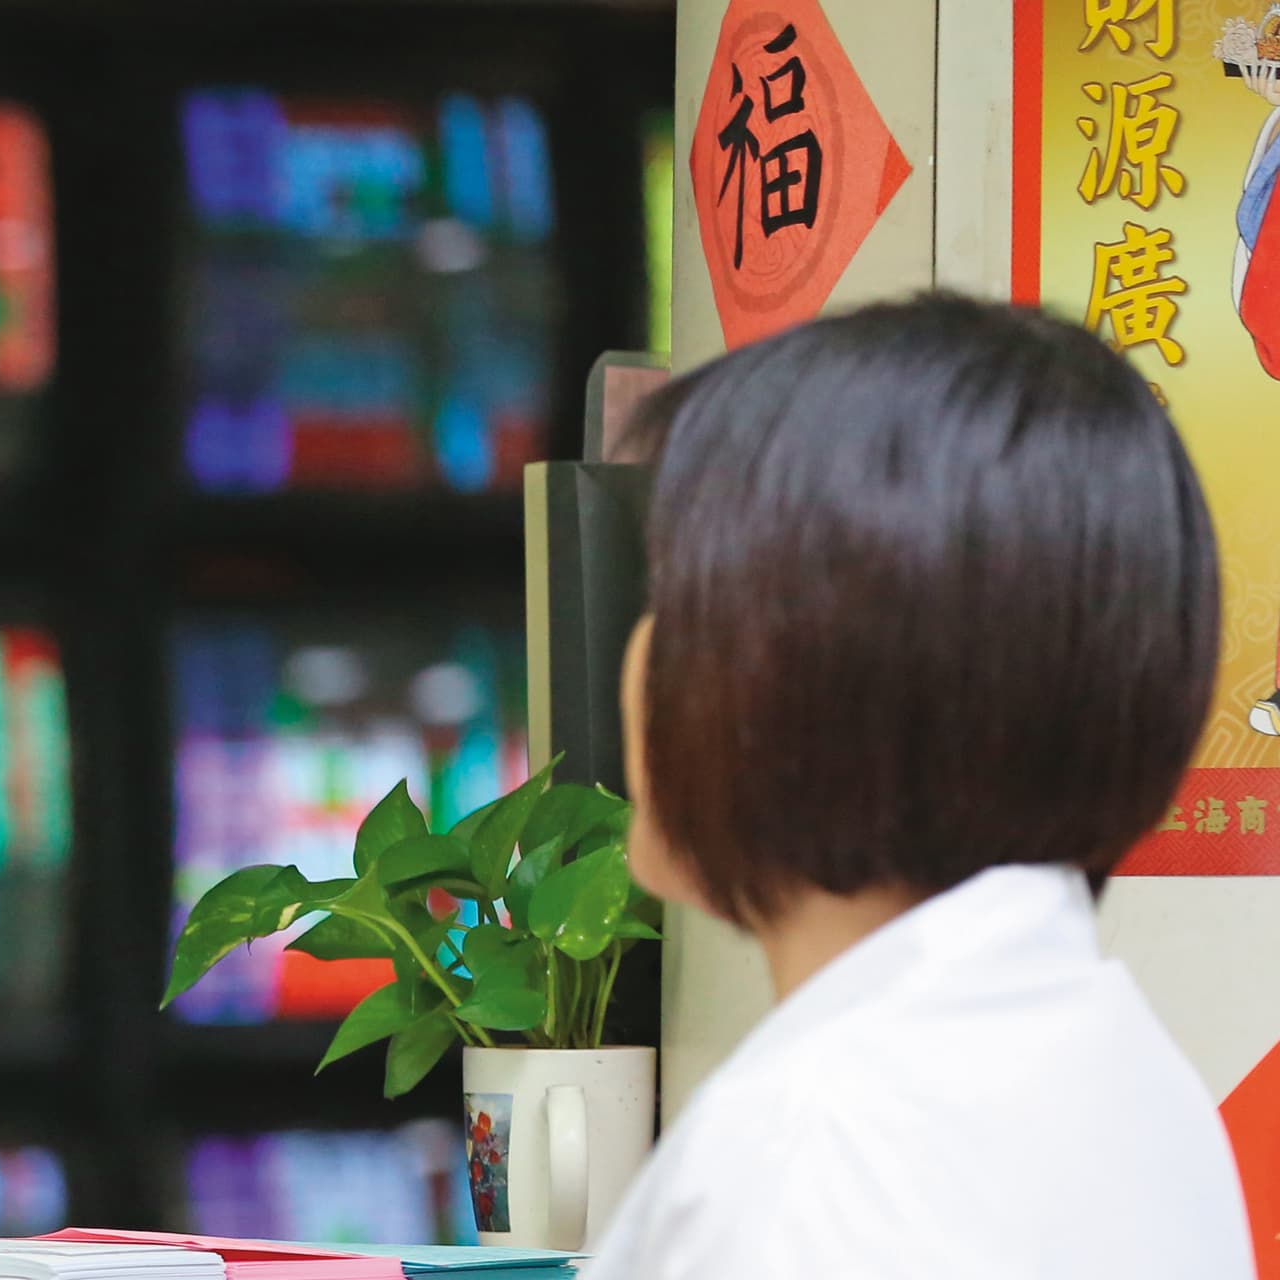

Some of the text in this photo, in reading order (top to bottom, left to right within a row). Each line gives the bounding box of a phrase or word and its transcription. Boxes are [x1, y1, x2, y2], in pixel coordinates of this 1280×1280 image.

[716, 23, 823, 271] 福
[1154, 795, 1280, 834] 上海商
